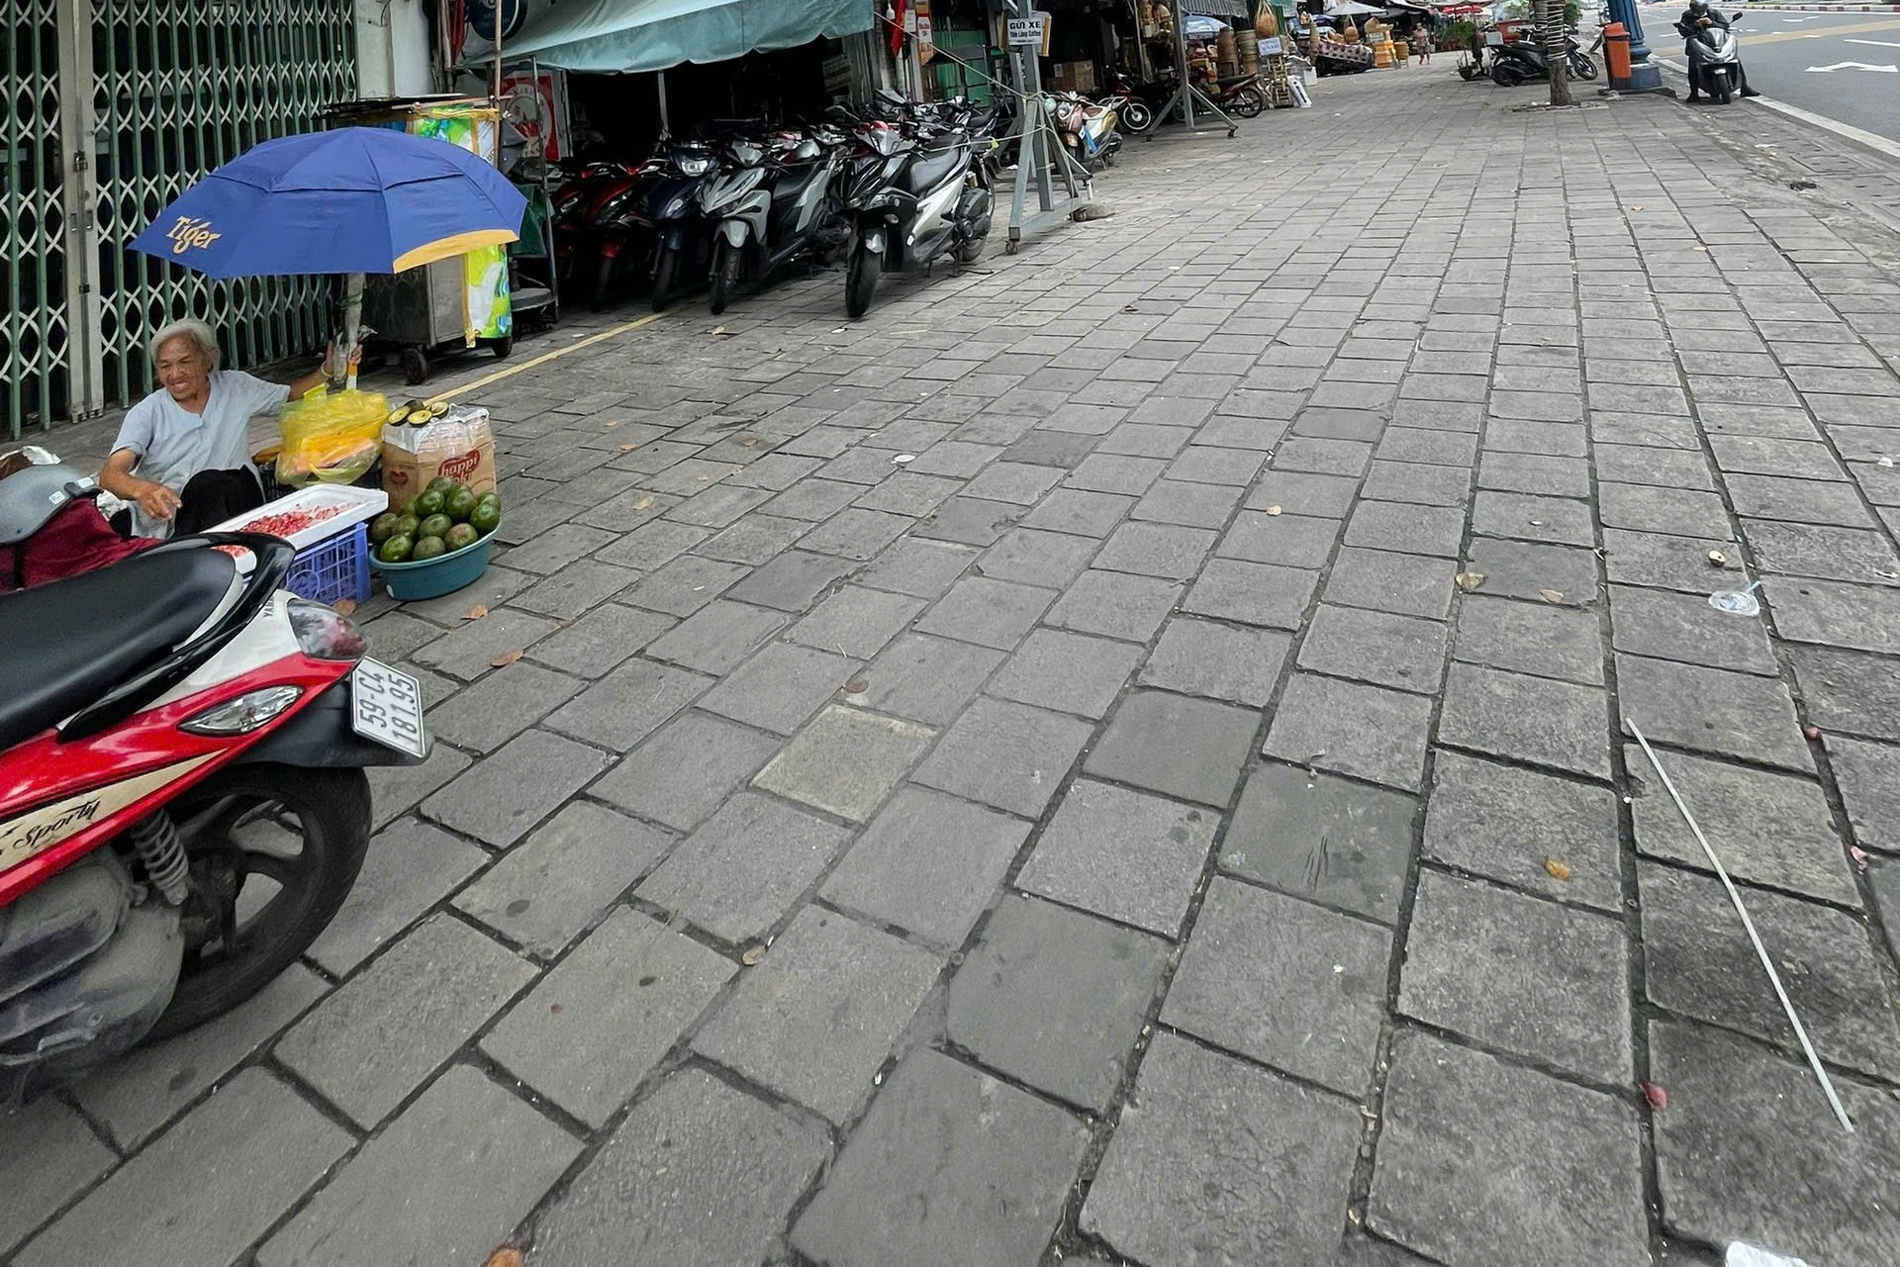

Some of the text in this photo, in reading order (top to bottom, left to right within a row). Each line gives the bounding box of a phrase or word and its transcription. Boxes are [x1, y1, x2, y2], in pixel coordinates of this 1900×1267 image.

[1028, 20, 1041, 29] XE
[166, 215, 222, 254] Tiger
[358, 668, 388, 728] 59-C4
[388, 673, 419, 744] 181.95
[13, 794, 103, 850] Sporty
